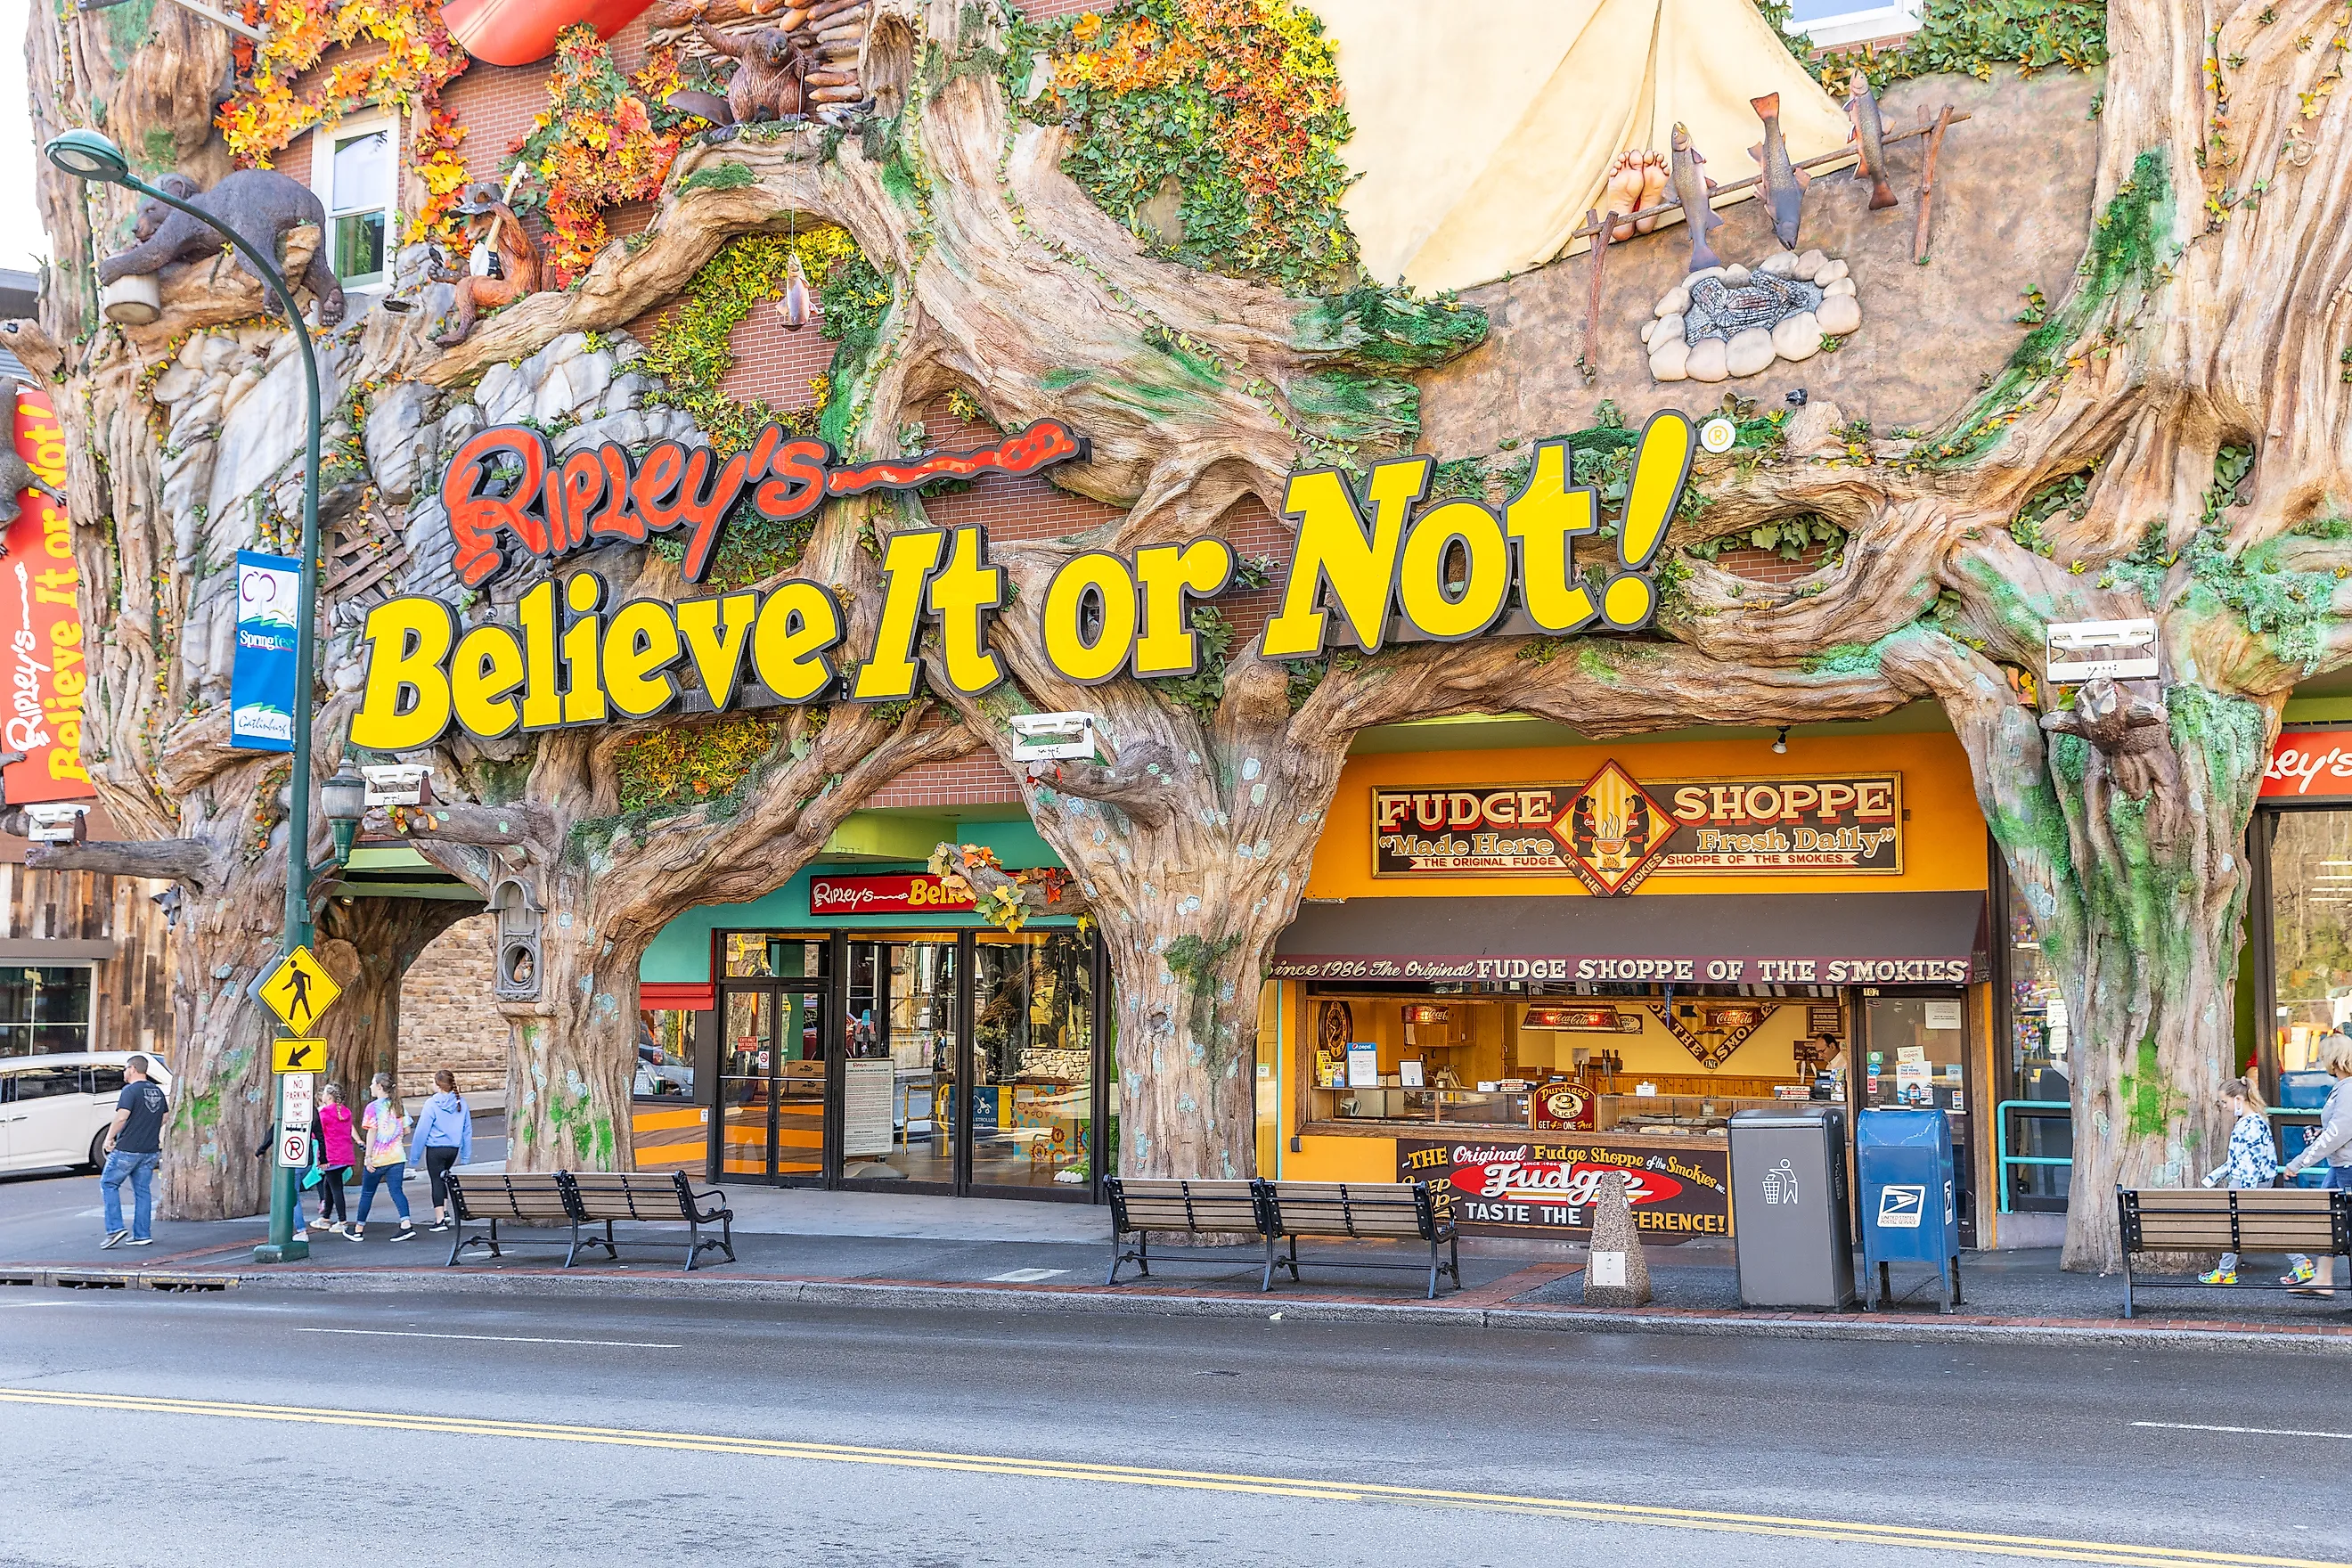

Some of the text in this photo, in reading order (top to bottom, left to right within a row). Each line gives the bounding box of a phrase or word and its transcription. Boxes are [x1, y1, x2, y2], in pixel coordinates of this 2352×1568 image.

[42, 508, 75, 559] or
[36, 568, 78, 608] It
[349, 407, 1695, 751] Believe It or Not!
[45, 619, 91, 785] Believe
[1378, 783, 1892, 829] FUDGE SHOPPE
[1471, 833, 1554, 855] Here
[1696, 827, 1790, 853] Fresh
[1425, 858, 1447, 867] THE
[1453, 857, 1507, 866] ORIGINAL
[1513, 857, 1557, 866] FUDGE
[1668, 854, 1720, 864] SHOPPE
[1727, 855, 1745, 863] OF
[1754, 854, 1779, 863] THE
[1563, 853, 1662, 895] OF THE SMOKIES
[1321, 960, 1367, 977] 1986
[1369, 960, 1401, 977] The
[1405, 960, 1476, 980] Original
[1477, 960, 1566, 979] FUDGE
[1575, 960, 1693, 981] SHOPPE
[1708, 960, 1744, 981] OF
[1758, 960, 1817, 982] THE
[1826, 960, 1969, 983] SMOKIES
[1554, 1014, 1588, 1025] Coca-Cola
[1716, 1012, 1752, 1024] Coca-Cola
[1672, 1023, 1703, 1057] THE
[286, 1090, 310, 1099] PARKING
[293, 1080, 303, 1089] NO
[1540, 1084, 1589, 1101] Purchase
[1552, 1108, 1579, 1117] SLICES
[1556, 1095, 1576, 1109] 3
[1539, 1121, 1550, 1129] GET
[1564, 1121, 1576, 1130] ONE
[1577, 1121, 1593, 1130] Free
[1408, 1146, 1449, 1169] THE
[1453, 1145, 1527, 1166] Original
[1533, 1146, 1587, 1164] Fudge
[1591, 1147, 1644, 1167] Shoppe
[1666, 1156, 1717, 1188] Smokies
[1465, 1203, 1531, 1222] TASTE
[1540, 1206, 1581, 1224] THE
